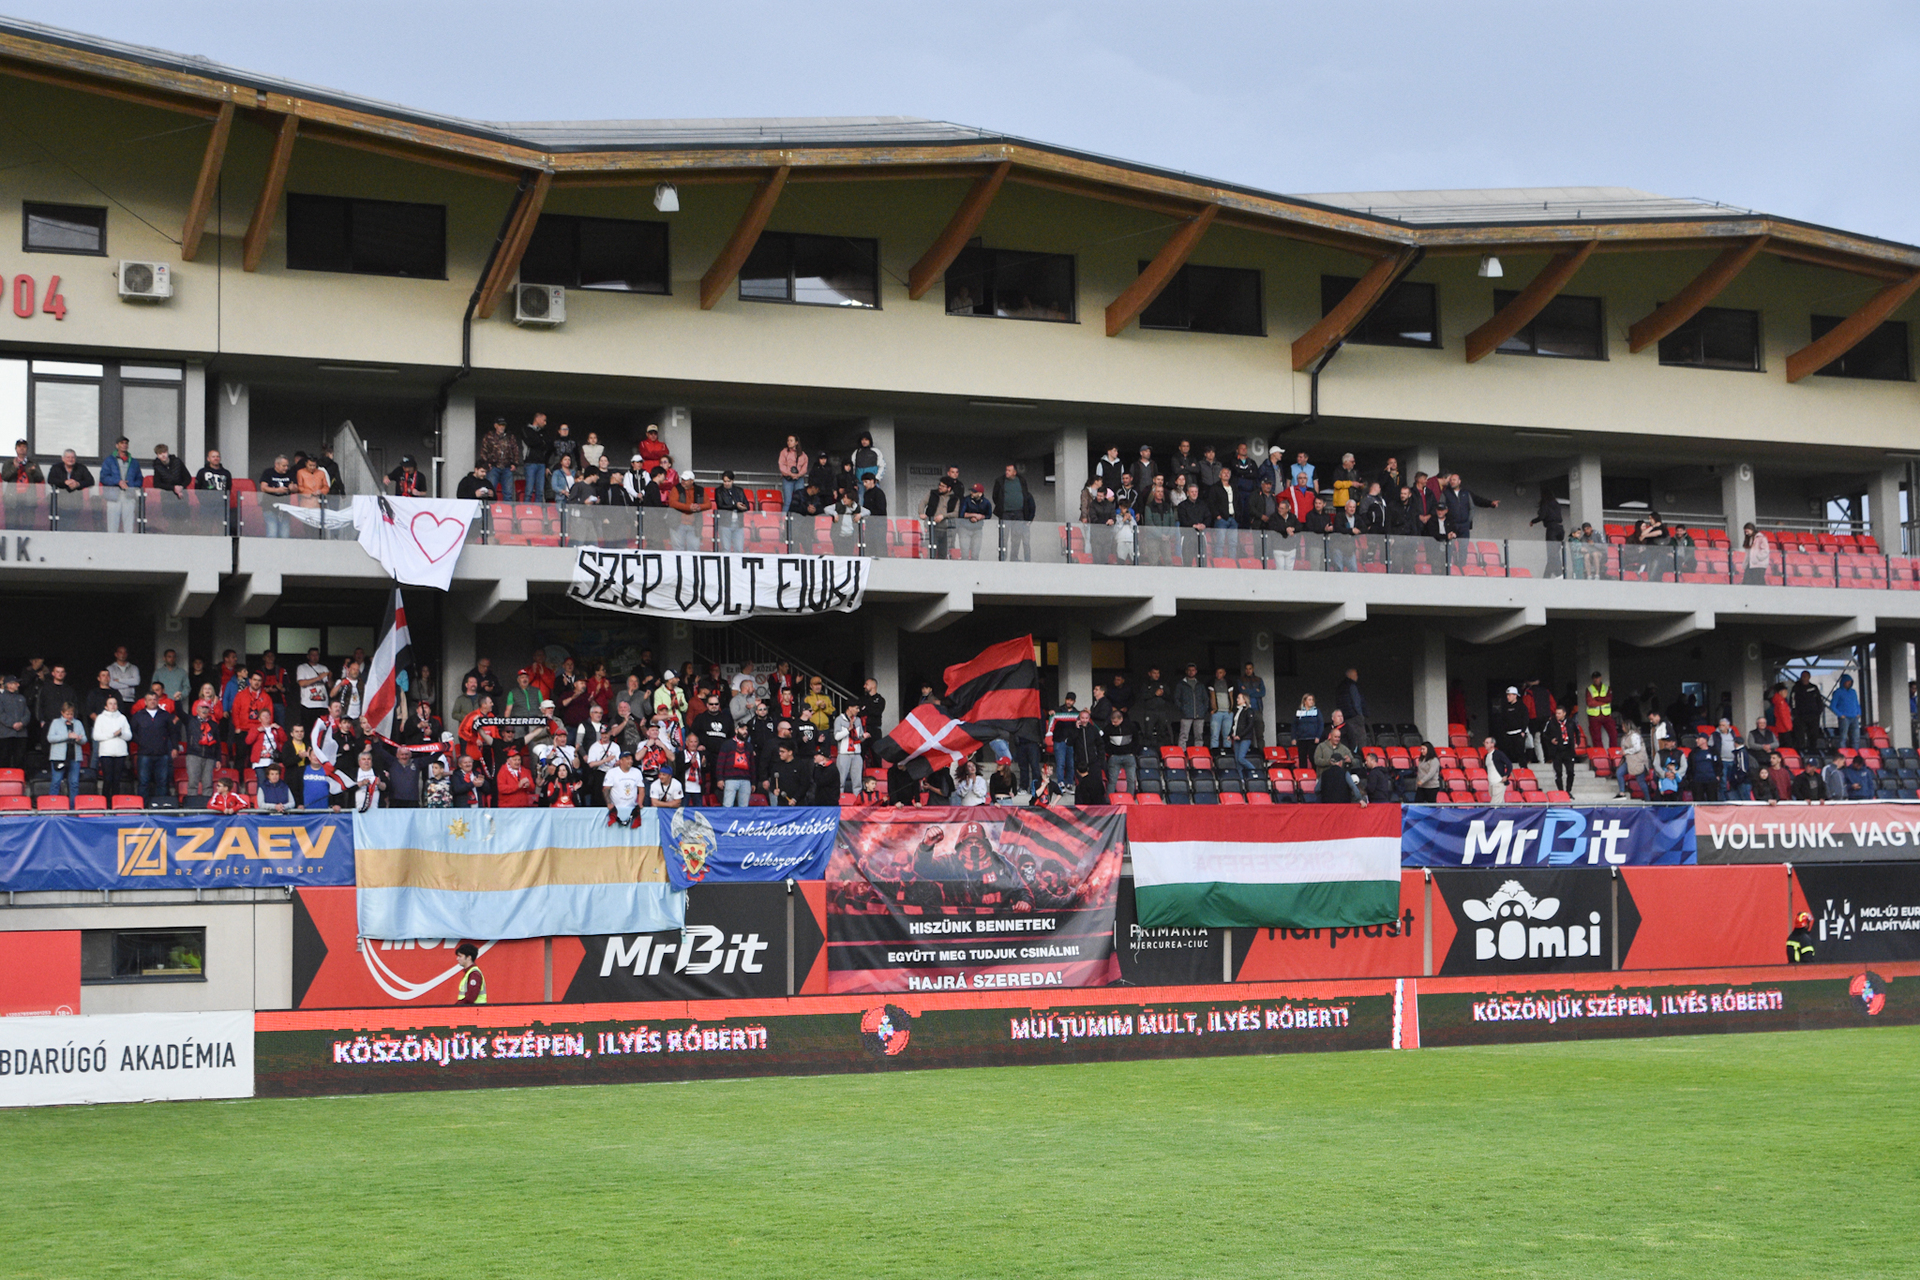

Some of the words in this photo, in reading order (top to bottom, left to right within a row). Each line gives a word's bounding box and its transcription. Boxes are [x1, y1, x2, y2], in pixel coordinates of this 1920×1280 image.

[0, 273, 67, 321] 04
[671, 406, 685, 427] F
[1251, 437, 1266, 457] G
[1738, 463, 1751, 482] G
[570, 549, 663, 609] SZÉP
[303, 772, 327, 781] adidas
[967, 824, 978, 834] 12
[1461, 809, 1630, 865] MrBit
[1709, 822, 1844, 850] VOLTUNK.
[175, 825, 337, 861] ZAEV
[175, 868, 193, 876] az
[262, 864, 324, 875] mester
[909, 919, 972, 935] HISZÜNK
[976, 918, 1056, 933] BENNETEK!
[599, 925, 769, 977] MrBit
[888, 949, 936, 963] EGYÜTT
[939, 950, 966, 961] MEG
[969, 948, 1017, 960] TUDJUK
[1020, 945, 1080, 959] CSINÁLNI!
[1130, 940, 1209, 950] MIERCUREA-CIUC
[908, 972, 967, 990] HAJRÁ
[973, 971, 1063, 988] SZEREDA!
[120, 1036, 237, 1072] AKADÉMIA
